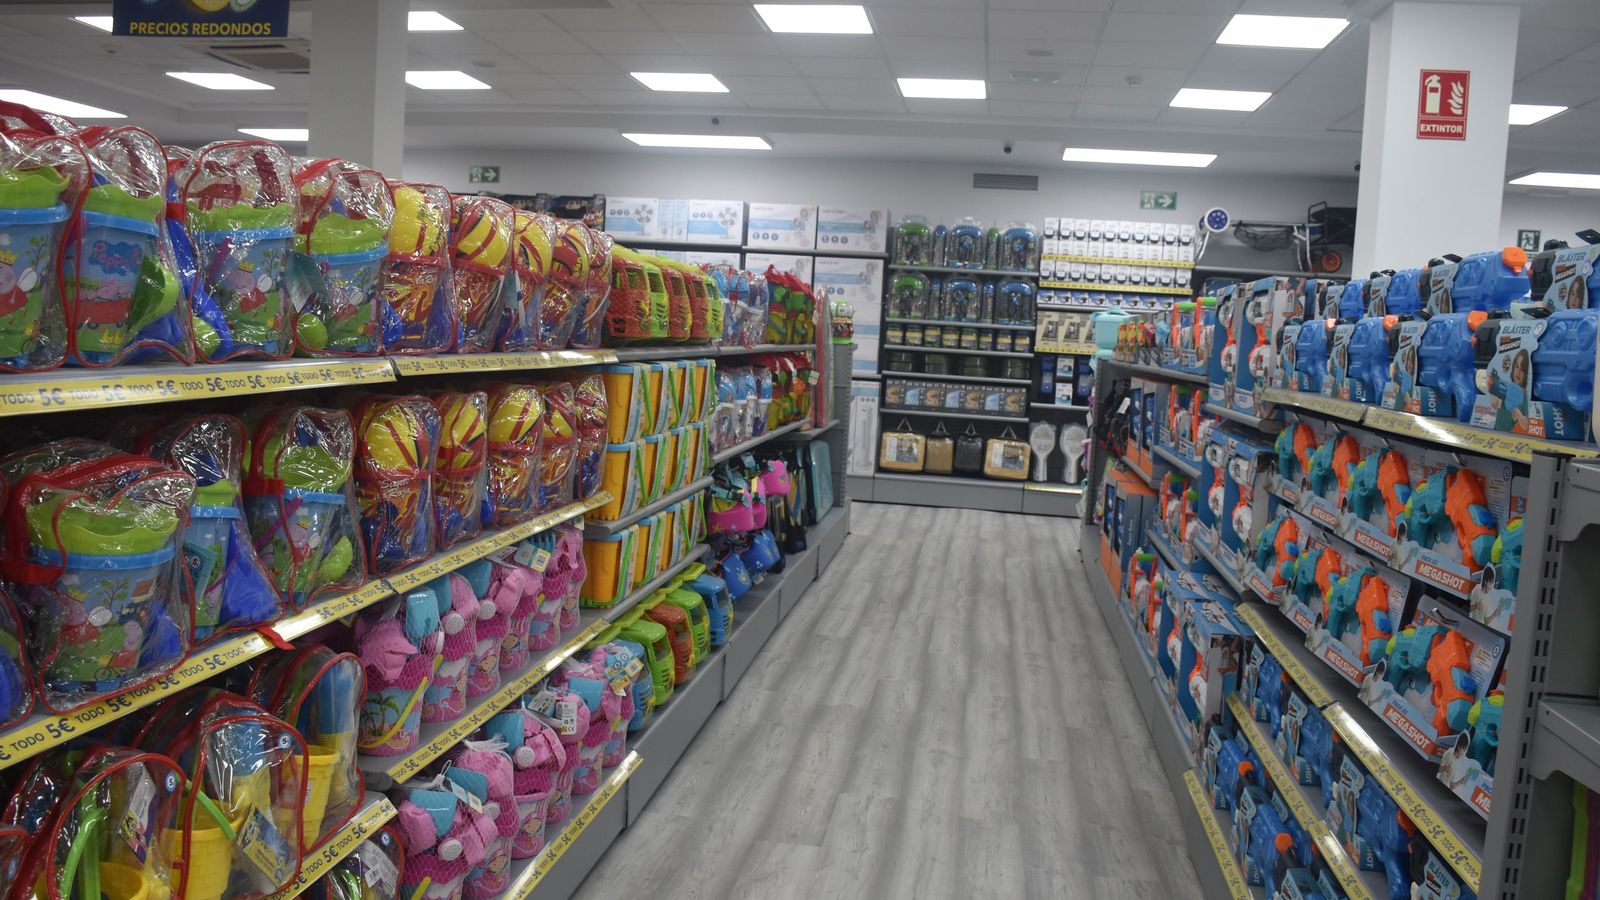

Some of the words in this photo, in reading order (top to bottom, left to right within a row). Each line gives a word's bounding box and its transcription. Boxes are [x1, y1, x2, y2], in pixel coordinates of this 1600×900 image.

[129, 22, 188, 35] PRECIOS
[192, 22, 271, 35] REDONDOS
[1420, 123, 1463, 133] EXTINTOR
[2, 394, 34, 405] TODO
[38, 388, 65, 406] 5€
[102, 384, 128, 401] 5€
[128, 384, 153, 395] TODO
[156, 380, 179, 395] 5€
[180, 381, 204, 392] TODO
[206, 377, 226, 392] 5€
[225, 379, 246, 389] TODO
[247, 375, 266, 389] 5€
[267, 376, 285, 385] TODO
[286, 372, 302, 384] 5€
[319, 369, 335, 381] 5€
[1356, 532, 1391, 557] MEGASHOT
[406, 574, 419, 584] 5€
[431, 564, 444, 575] 5€
[1418, 564, 1465, 590] MEGASHOT
[316, 607, 334, 620] 5€
[332, 603, 348, 612] TODO
[347, 595, 364, 607] 5€
[361, 589, 376, 600] TODO
[1327, 650, 1359, 680] MEGASHOT
[11, 732, 45, 752] TODO
[46, 718, 75, 739] 5€
[75, 706, 105, 725] TODO
[106, 695, 132, 712] 5€
[129, 684, 156, 700] TODO
[157, 673, 180, 690] 5€
[179, 665, 204, 679] TODO
[203, 654, 226, 670] 5€
[223, 646, 245, 660] TODO
[404, 759, 419, 772] 5€
[417, 751, 430, 761] TODO
[428, 743, 442, 755] 5€
[449, 729, 462, 739] 5€
[469, 715, 481, 725] 5€
[488, 702, 500, 711] 5€
[1387, 708, 1430, 749] MEGASHOT
[304, 858, 323, 875] TODO
[322, 846, 339, 864] 5€
[336, 836, 353, 850] TODO
[351, 823, 367, 839] 5€
[365, 812, 380, 826] TODO
[379, 803, 394, 816] 5€
[1392, 783, 1406, 796] 5€
[1410, 804, 1424, 818] 5€
[1428, 825, 1445, 839] 5€
[1440, 836, 1455, 852] TODO
[1450, 850, 1468, 865] 5€
[1463, 860, 1479, 878] TODO
